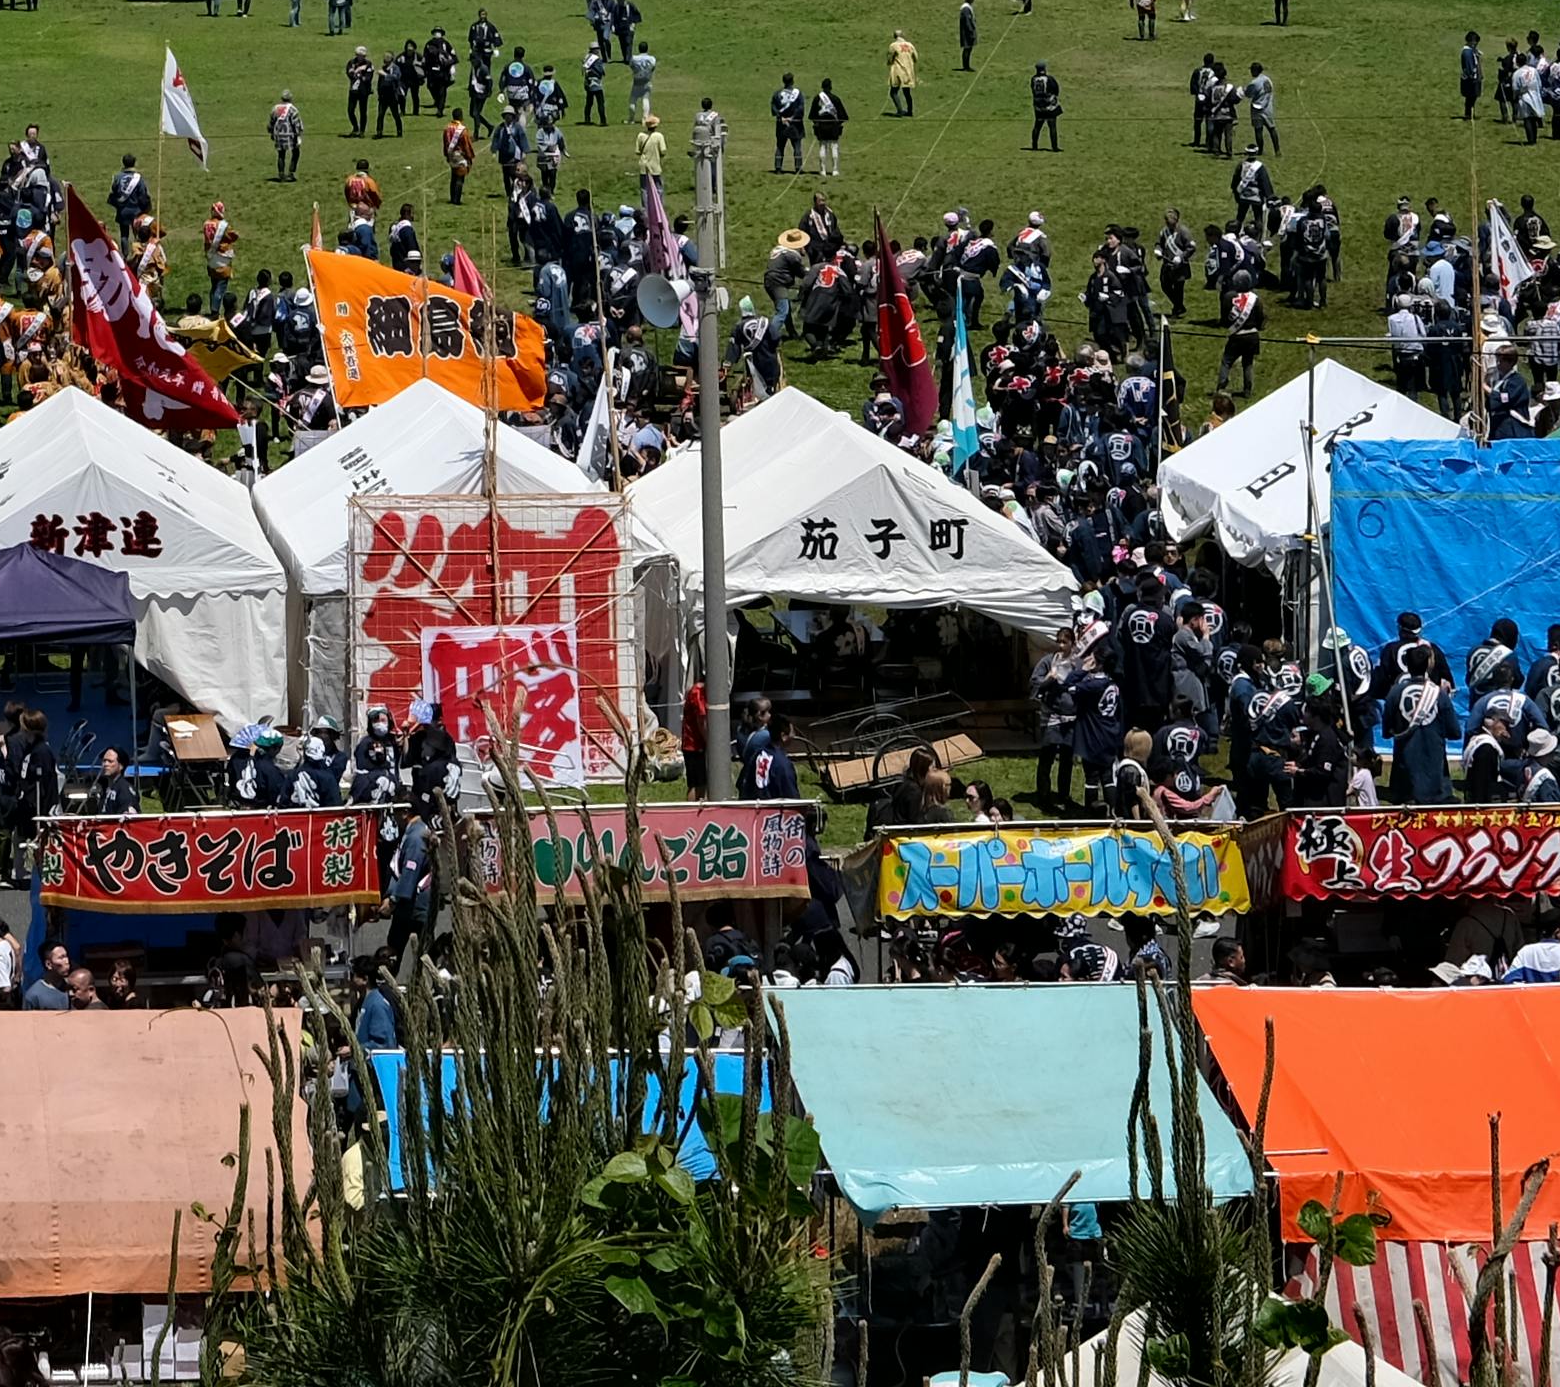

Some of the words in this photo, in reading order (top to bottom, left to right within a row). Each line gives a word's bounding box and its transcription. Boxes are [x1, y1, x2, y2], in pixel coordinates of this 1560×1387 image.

[29, 510, 163, 558] 新津連
[798, 517, 969, 560] 茄子町
[1357, 499, 1387, 539] 6
[83, 826, 304, 895] やきそば
[321, 816, 358, 887] 特製
[762, 813, 784, 878] 風物詩
[897, 836, 1221, 912] スーパーボールすくい
[1295, 813, 1365, 889] 極上
